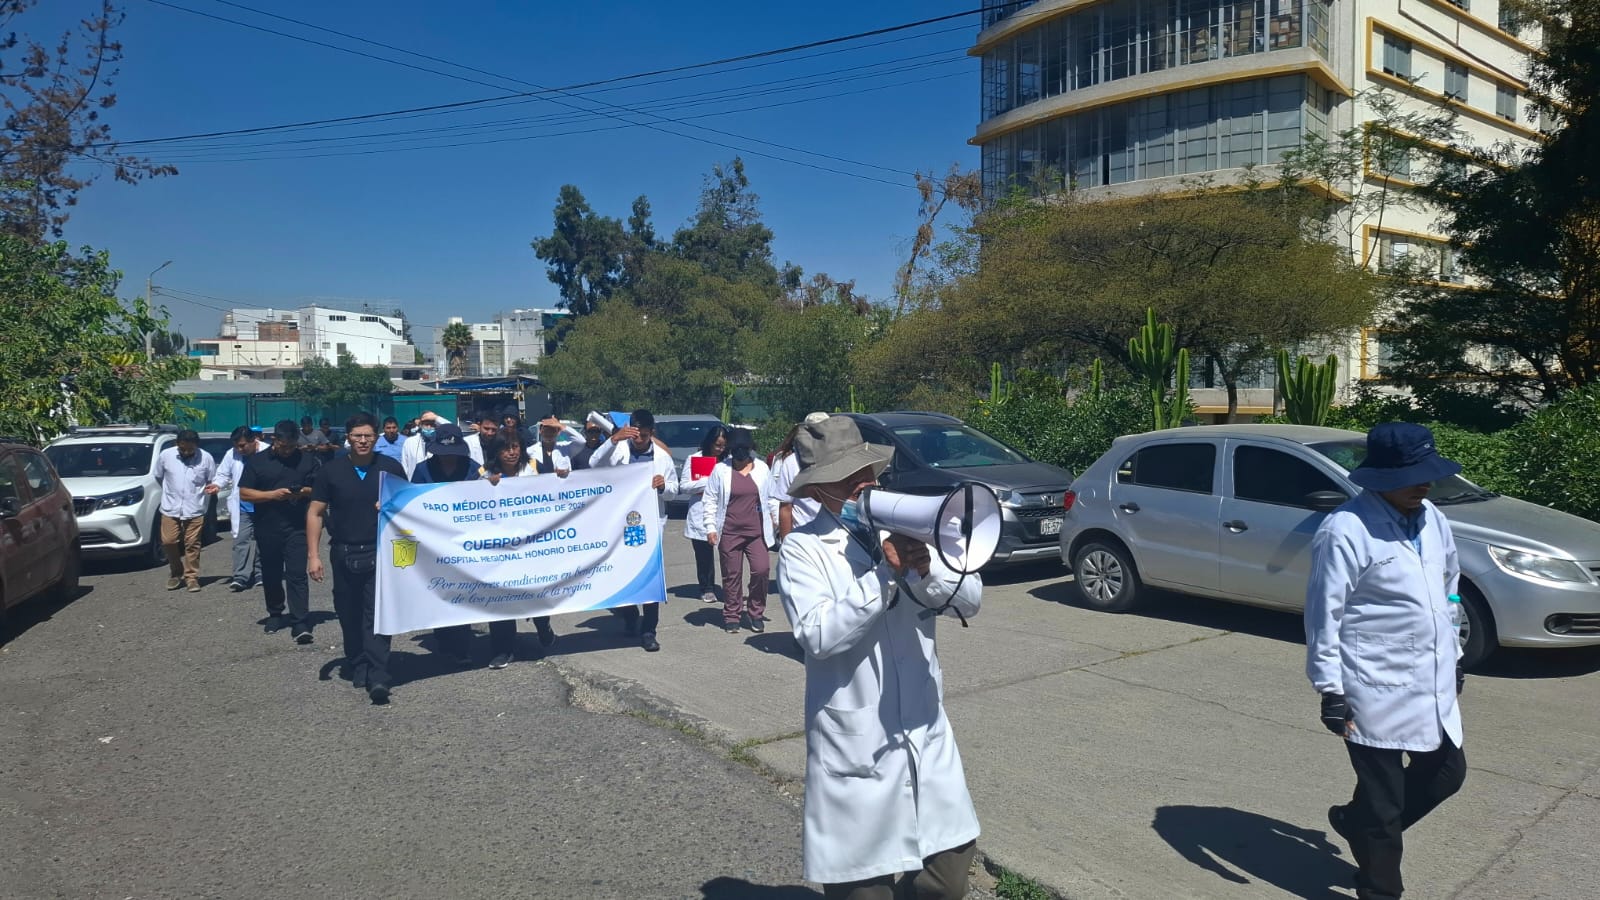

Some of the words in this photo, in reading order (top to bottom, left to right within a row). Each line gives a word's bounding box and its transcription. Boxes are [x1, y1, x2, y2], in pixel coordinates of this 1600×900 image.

[423, 502, 449, 512] PARO
[452, 499, 497, 512] MÉDICO
[499, 493, 556, 508] REGIONAL
[558, 485, 613, 501] INDEFINIDO
[453, 513, 482, 523] DESDE
[484, 512, 497, 521] EL
[499, 511, 508, 519] 16
[511, 506, 551, 517] FEBRERO
[555, 503, 566, 512] DE
[436, 555, 479, 565] HOSPITAL
[480, 552, 523, 563] REGIONAL
[525, 546, 565, 559] HONORIO
[567, 540, 608, 553] DELGADO
[463, 536, 521, 551] CUERPO
[427, 576, 455, 590] Por
[458, 581, 501, 594] mejores
[503, 573, 558, 588] condiciones
[560, 571, 573, 581] en
[574, 562, 613, 579] beneficio
[451, 593, 465, 604] de
[469, 592, 484, 604] los
[484, 590, 534, 607] pacientes
[536, 586, 550, 599] de
[551, 585, 560, 597] la
[562, 580, 592, 598] región
